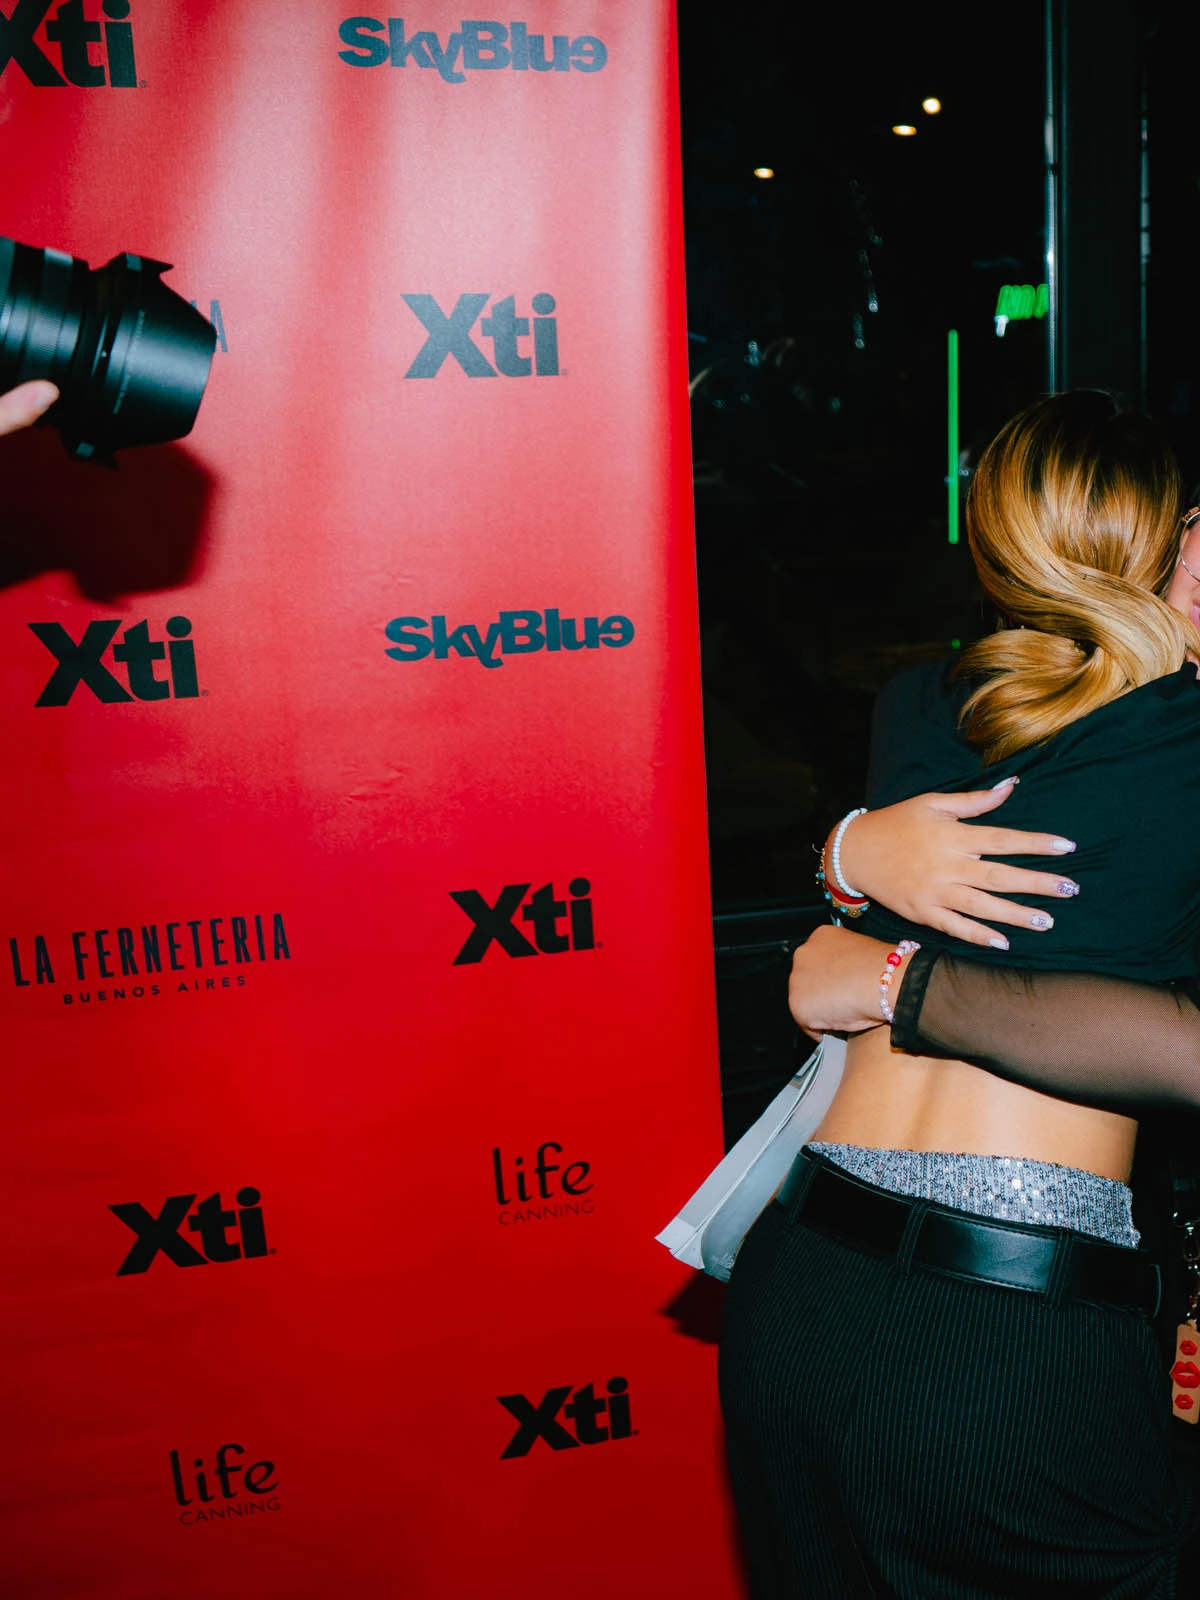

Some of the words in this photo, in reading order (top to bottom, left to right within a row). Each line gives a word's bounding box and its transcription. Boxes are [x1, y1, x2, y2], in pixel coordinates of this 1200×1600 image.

[337, 16, 608, 84] SkyBlue
[401, 292, 561, 379] Xti
[27, 615, 200, 708] Xti
[384, 608, 635, 669] SkyBlue
[9, 935, 55, 987] LA
[72, 913, 291, 981] FERNETERIA
[448, 877, 595, 966] Xti
[63, 985, 161, 1004] BUENOS
[177, 976, 246, 993] AIRES
[493, 1141, 594, 1206] life
[107, 1186, 268, 1277] Xti
[498, 1200, 595, 1226] CANNING
[496, 1376, 632, 1460] Xti
[169, 1443, 279, 1507] life
[178, 1498, 281, 1526] CANNING
